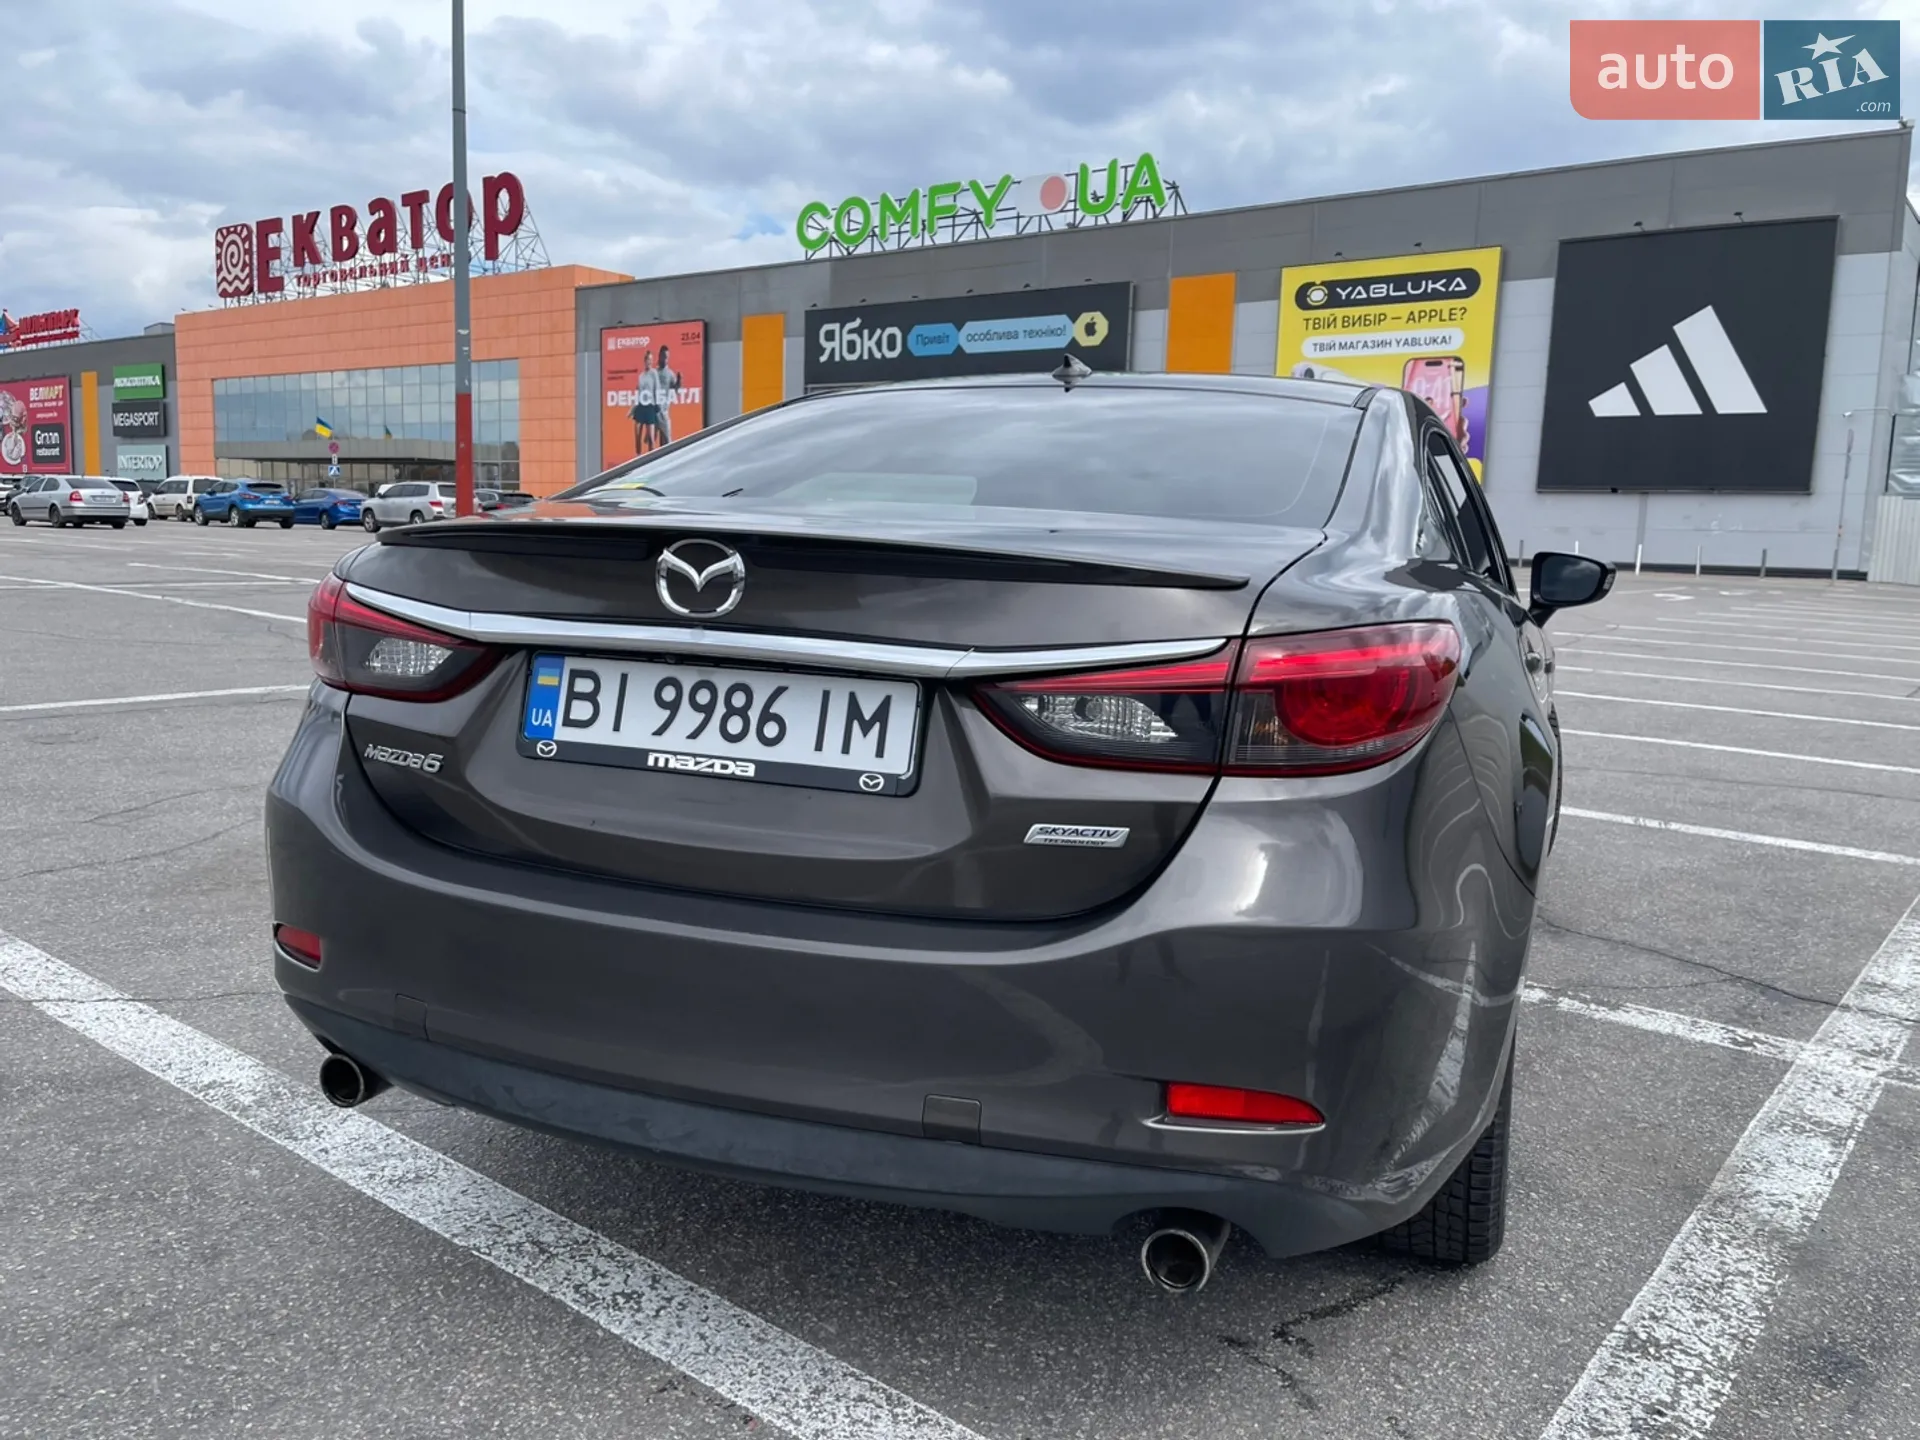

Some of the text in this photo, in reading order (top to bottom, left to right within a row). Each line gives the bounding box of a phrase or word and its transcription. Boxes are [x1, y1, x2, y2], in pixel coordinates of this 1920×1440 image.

[796, 152, 1168, 251] COMFY UA
[1336, 277, 1467, 300] YABLUKA
[1303, 313, 1337, 331] ТВІЙ
[1342, 312, 1387, 329] ВИБІР
[1406, 307, 1467, 325] APPLE?
[819, 317, 902, 363] Ябко
[916, 331, 950, 348] Привіт
[966, 326, 1019, 342] особлива
[1312, 335, 1452, 352] ТВІЙ МАГАЗИН YABLUKA!
[113, 411, 159, 427] MEGASPORT
[118, 455, 162, 470] INTERTOP
[531, 708, 553, 728] UA
[562, 668, 892, 759] BI 9986 IM
[1037, 826, 1119, 838] SKYACTIV
